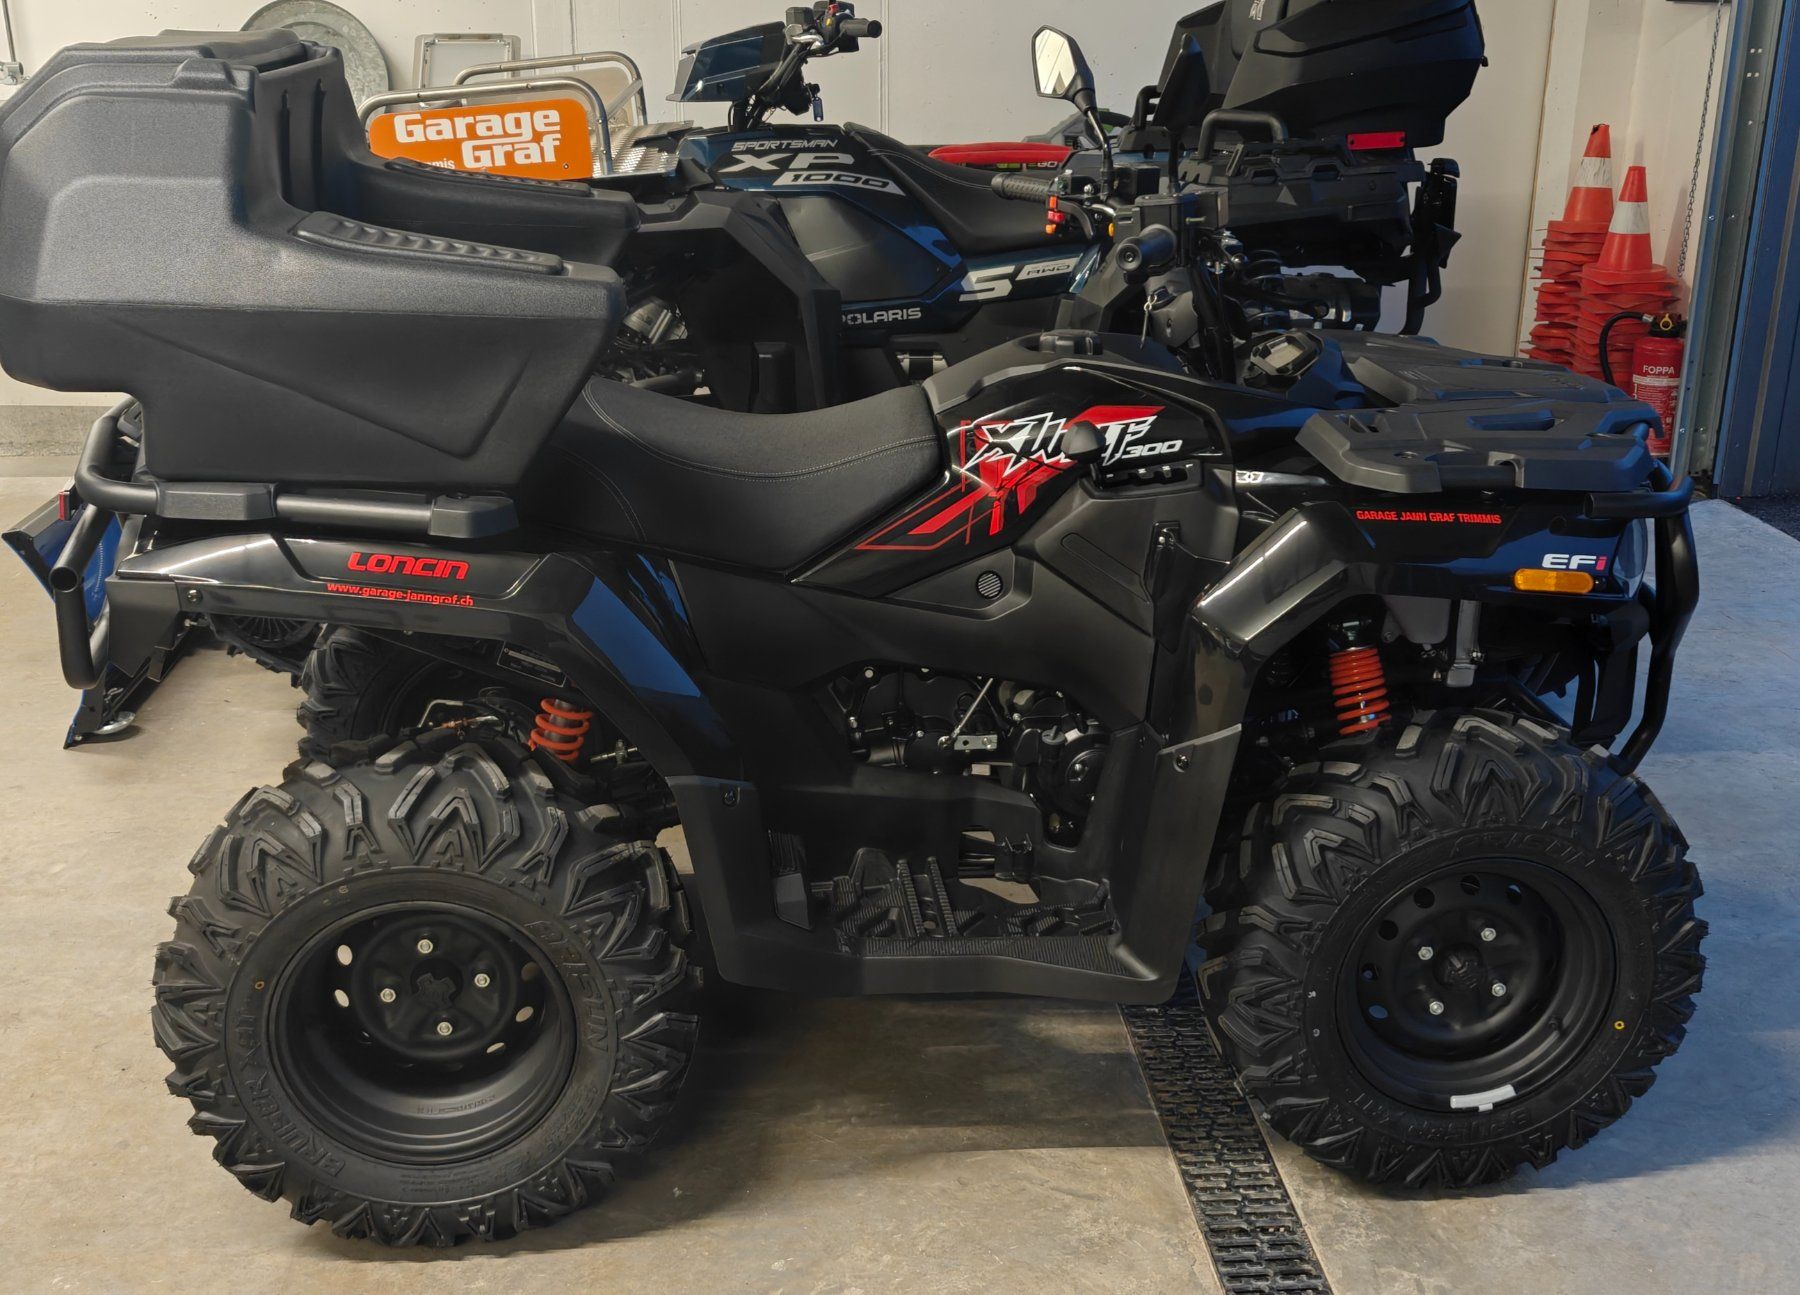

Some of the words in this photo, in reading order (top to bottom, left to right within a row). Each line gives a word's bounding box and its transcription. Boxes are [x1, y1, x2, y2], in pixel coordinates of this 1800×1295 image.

[394, 109, 561, 144] Garage
[461, 133, 562, 169] Graf
[731, 139, 838, 152] SPORTSMAN
[717, 153, 855, 173] XP
[791, 173, 890, 188] 1000
[959, 265, 1016, 302] S
[1642, 364, 1675, 375] FOPPA
[1121, 439, 1184, 459] 300
[1355, 510, 1399, 521] GARAGE
[1400, 511, 1427, 522] JANN
[1429, 512, 1455, 523] GRAF
[1456, 513, 1503, 525] TRIMMIS
[347, 551, 471, 581] LONCIN
[1541, 553, 1608, 571] EFi
[326, 582, 475, 607] www.garage-janngraf.ch
